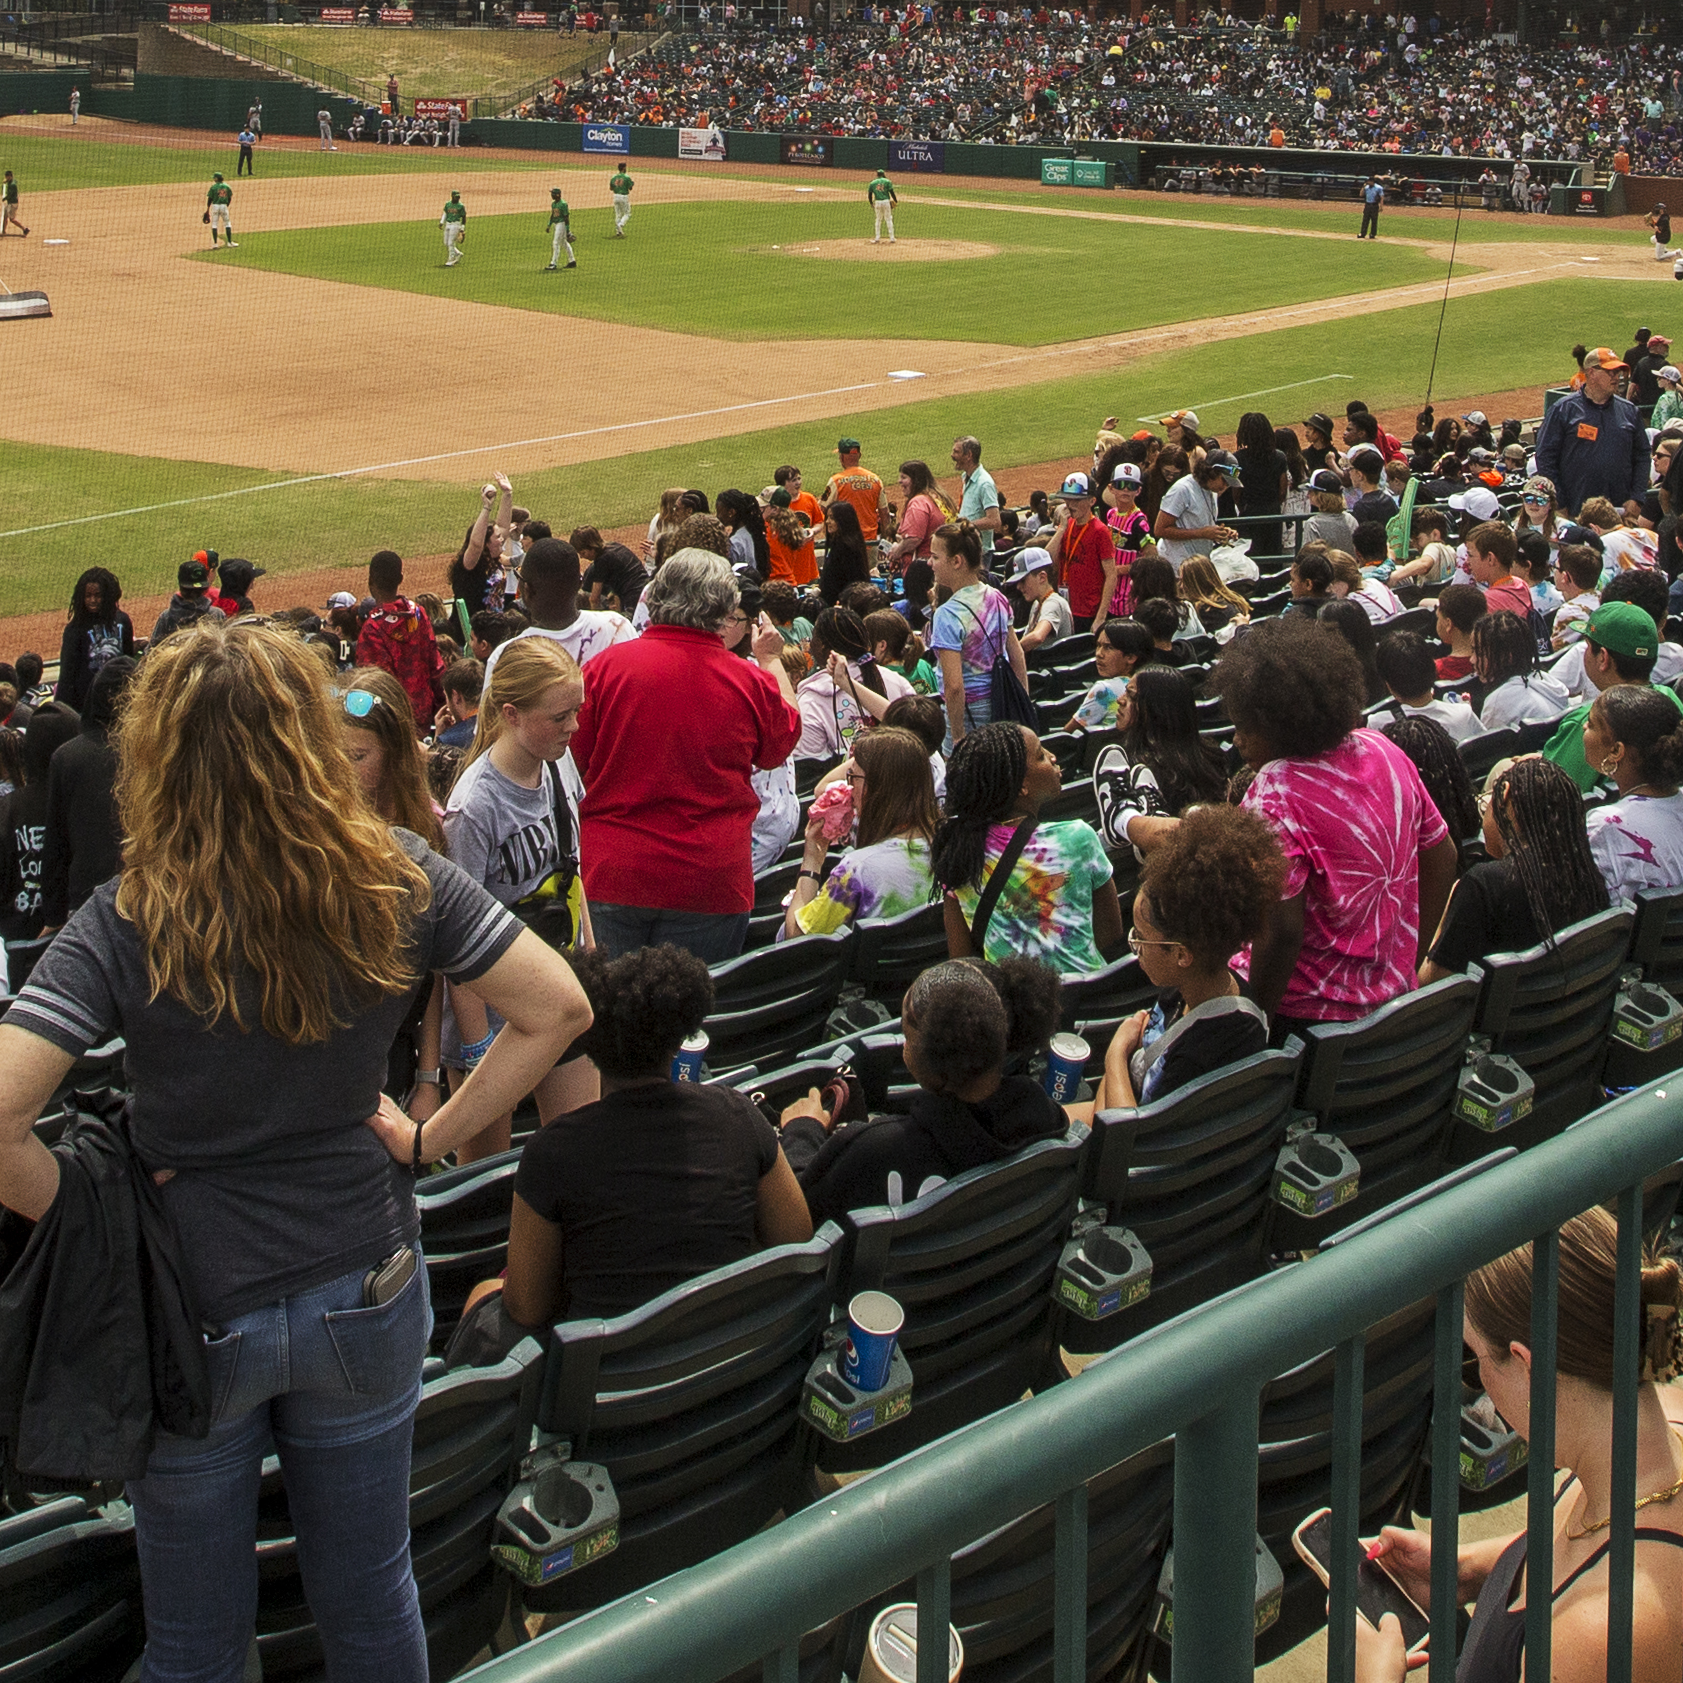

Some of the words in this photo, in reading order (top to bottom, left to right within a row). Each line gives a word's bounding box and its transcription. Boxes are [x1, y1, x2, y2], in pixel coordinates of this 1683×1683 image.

[587, 129, 623, 146] Clayton
[898, 150, 934, 162] ULTRA
[1044, 163, 1069, 173] Great
[1046, 172, 1067, 182] Clips
[15, 824, 46, 852] NE
[1051, 1069, 1067, 1101] epsi
